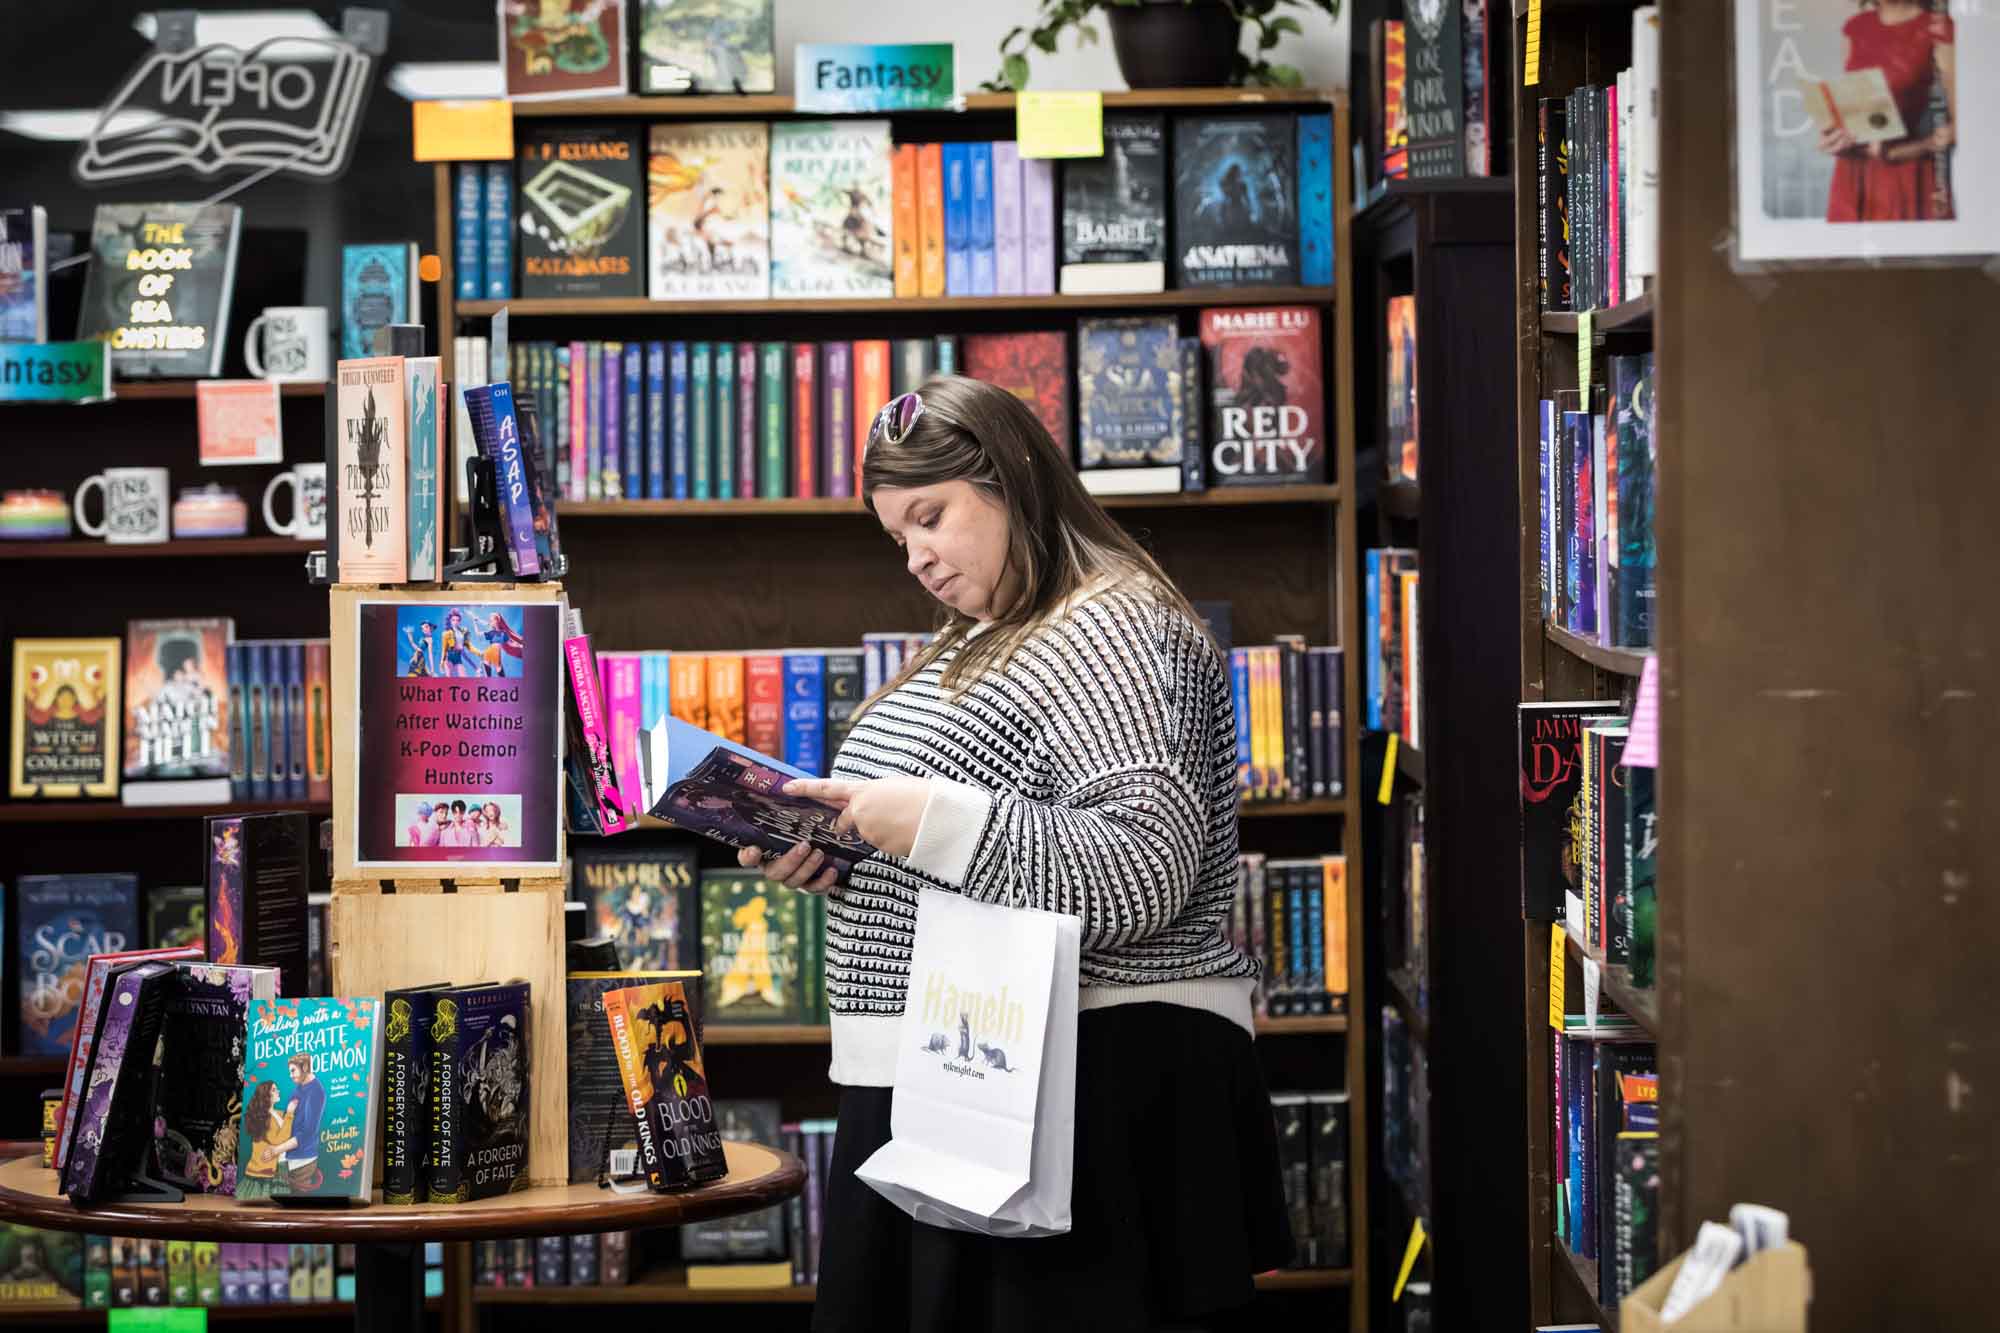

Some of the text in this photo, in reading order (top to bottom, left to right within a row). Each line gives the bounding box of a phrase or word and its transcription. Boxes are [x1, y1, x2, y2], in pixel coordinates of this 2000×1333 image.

[816, 60, 942, 90] Fantasy
[559, 143, 630, 160] KUANG
[143, 222, 185, 244] THE
[1076, 220, 1153, 244] BABEL
[127, 248, 193, 270] BOOK
[138, 273, 174, 297] OF
[130, 300, 172, 323] SEA
[1212, 311, 1310, 330] MARIE LU
[0, 357, 93, 385] ntasy
[1221, 405, 1309, 441] RED
[499, 415, 524, 505] ASAP
[1212, 438, 1314, 475] CITY
[345, 463, 390, 491] PRIESS
[400, 685, 520, 702] What To Read
[570, 645, 584, 689] AURORA
[578, 688, 594, 729] ASCHER
[397, 713, 524, 730] After Watching
[33, 731, 96, 745] WITCH
[400, 741, 517, 757] K-Pop Demon
[425, 768, 493, 785] Hunters
[211, 1003, 230, 1016] TAN
[253, 1008, 341, 1039] Dealing with a
[254, 1024, 348, 1060] DESPERATE
[613, 1014, 632, 1061] BLOOD
[310, 1045, 367, 1073] DEMON
[387, 1052, 395, 1166] ELIZABETH LIM
[395, 1053, 405, 1168] A FORGERY OF FATE
[441, 1053, 451, 1168] A FORGERY OF FATE
[631, 1088, 647, 1120] OLD
[658, 1095, 713, 1132] BLOOD
[320, 1125, 360, 1142] Charlotte
[638, 1121, 657, 1166] KINGS
[662, 1130, 722, 1159] OLD KINGS
[467, 1144, 524, 1168] A FORGERY
[475, 1166, 516, 1185] OF FATE
